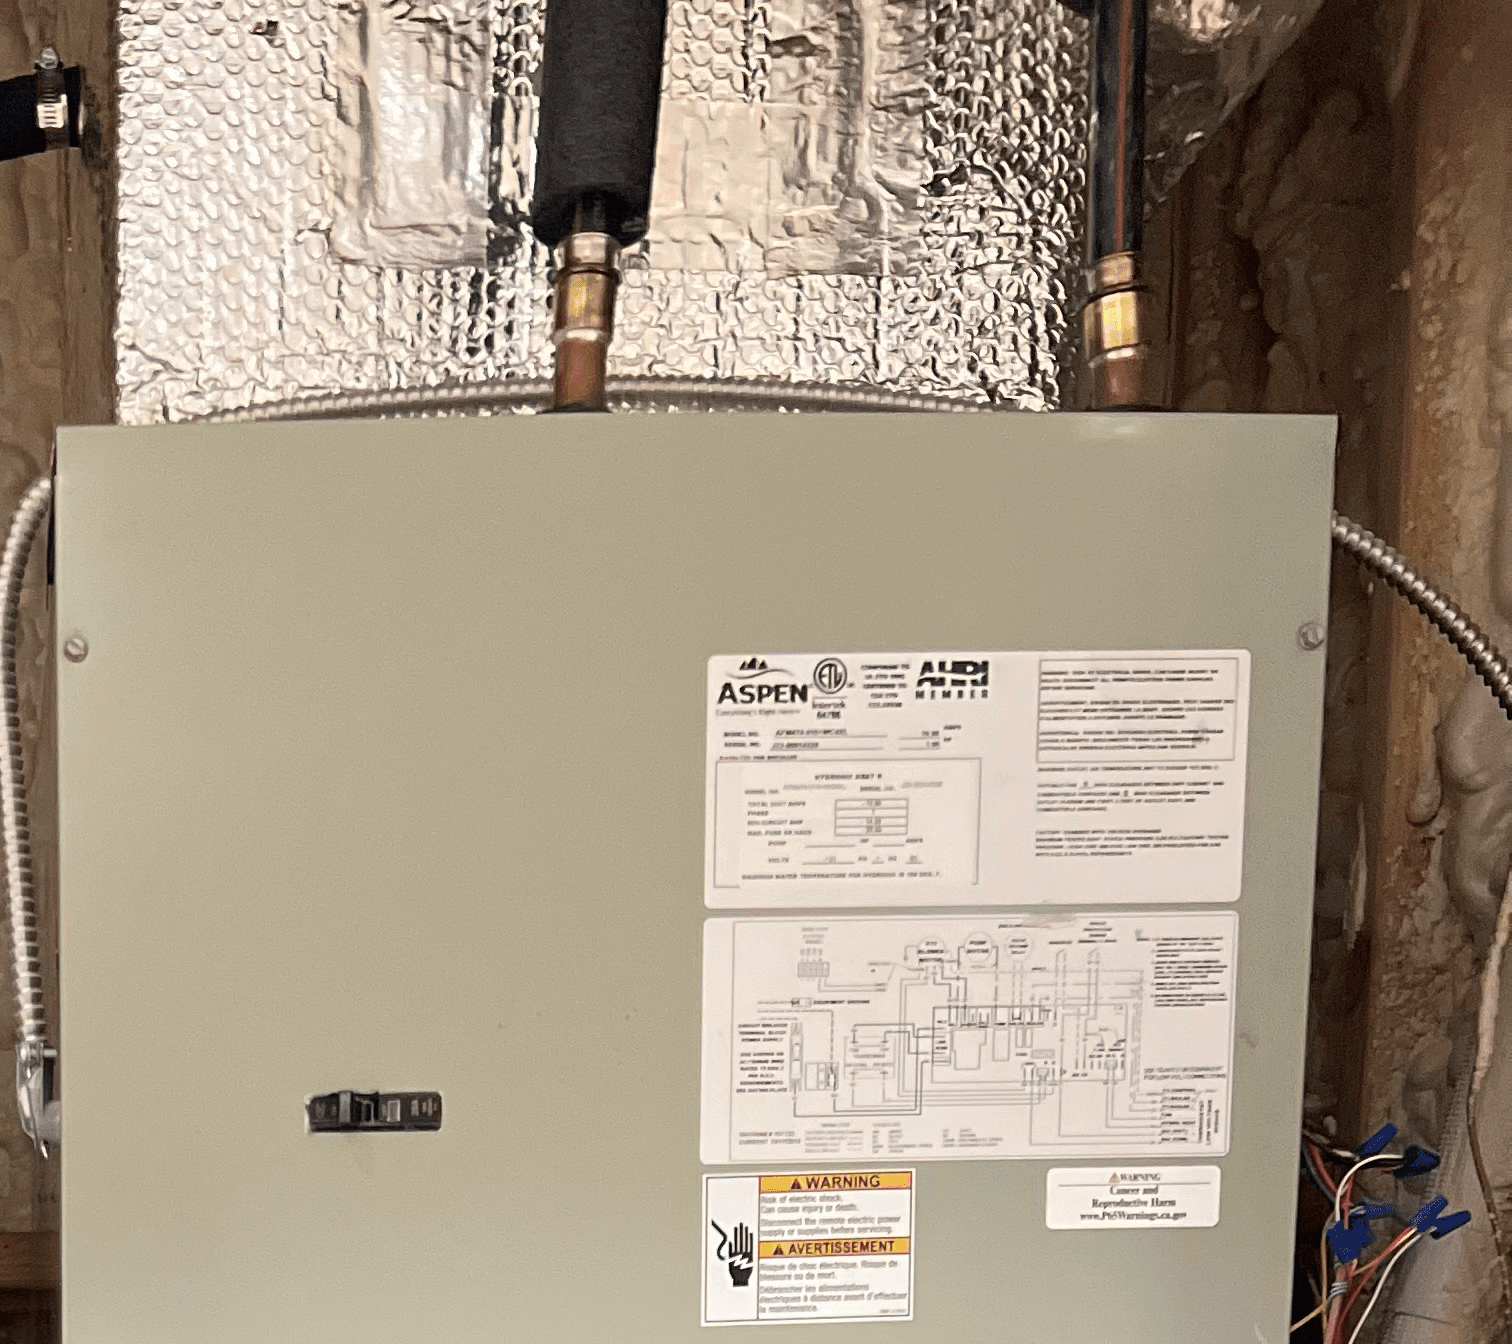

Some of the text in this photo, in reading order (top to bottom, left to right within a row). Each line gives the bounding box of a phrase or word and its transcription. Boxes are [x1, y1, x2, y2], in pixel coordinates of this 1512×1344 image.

[717, 682, 808, 704] ASPEN
[805, 1175, 881, 1189] WARNING
[1120, 1173, 1161, 1182] WARNING
[1109, 1185, 1159, 1195] Cancer and
[1092, 1197, 1177, 1209] Reproductive Harm
[788, 1240, 895, 1255] AVERTISSEMENT
